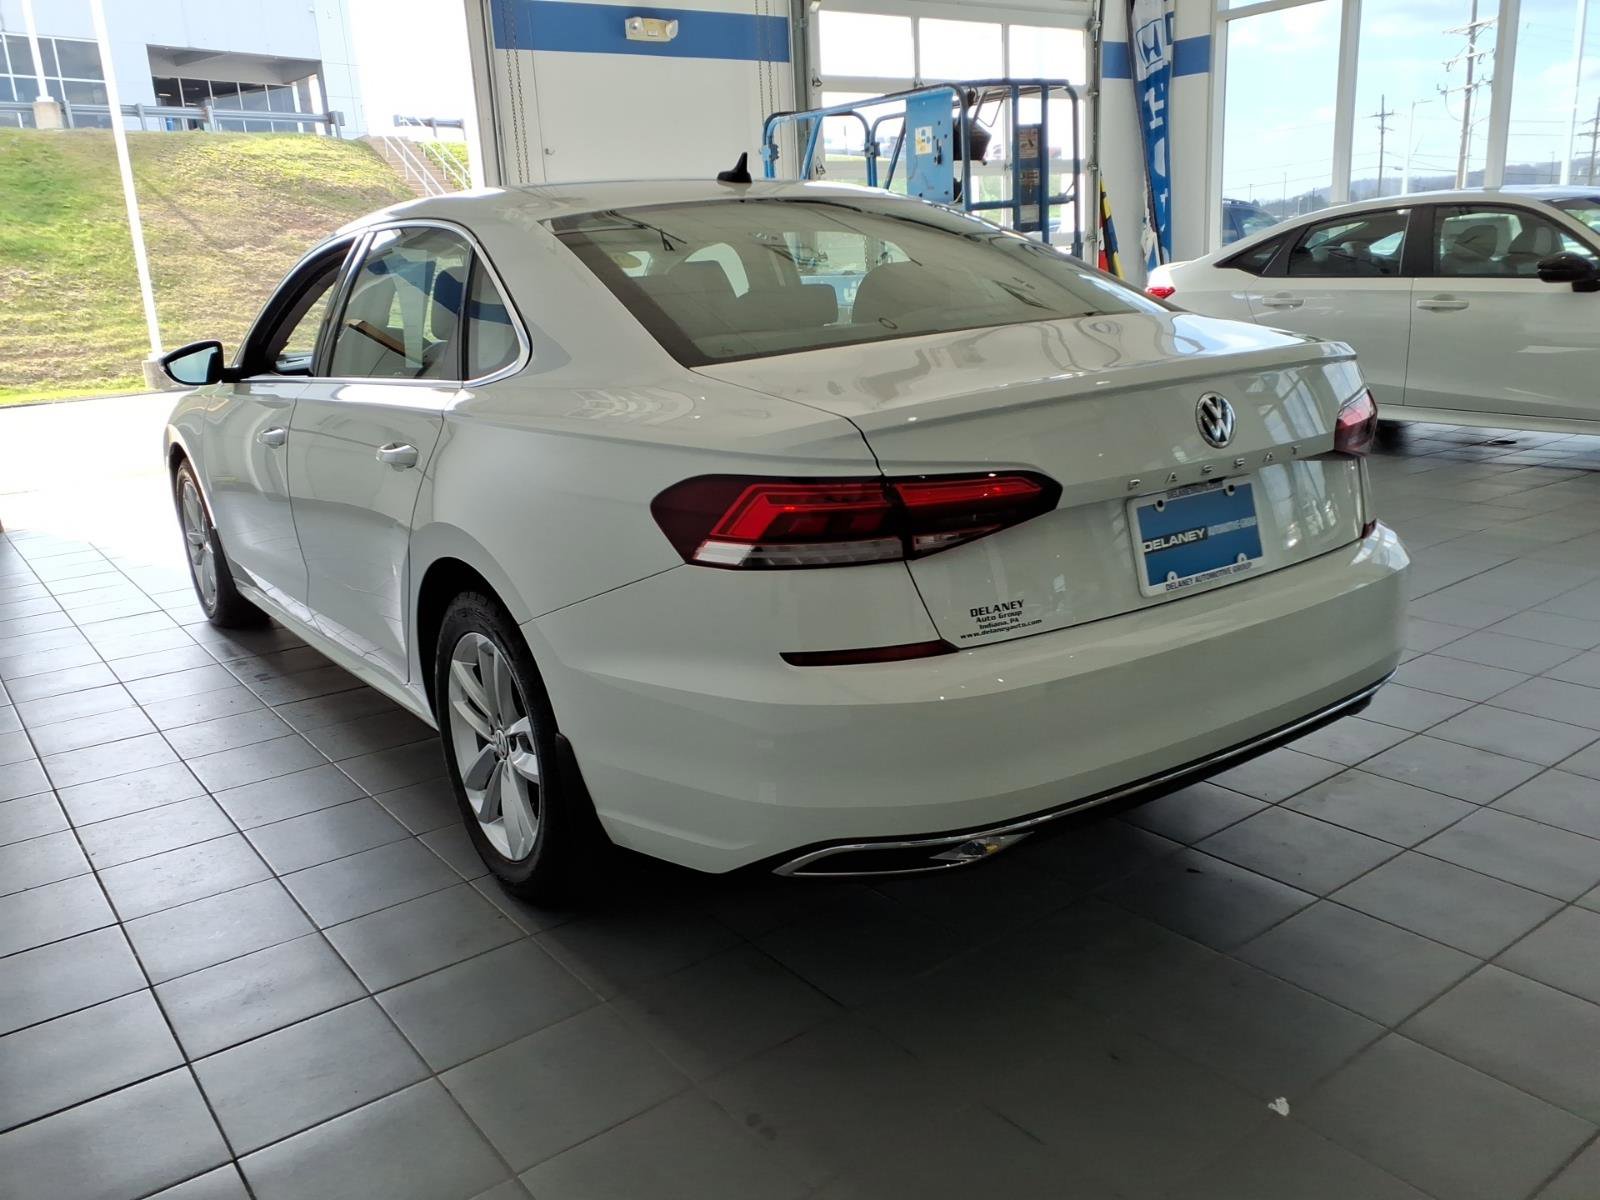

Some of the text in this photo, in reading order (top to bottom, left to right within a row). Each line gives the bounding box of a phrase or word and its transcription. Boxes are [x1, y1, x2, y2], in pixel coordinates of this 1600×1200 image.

[1128, 445, 1301, 490] PASSAT
[1143, 527, 1206, 553] DELANEY
[1165, 577, 1193, 592] DELANEY
[970, 600, 1024, 617] DELANEY
[976, 609, 1022, 623] Auto Group
